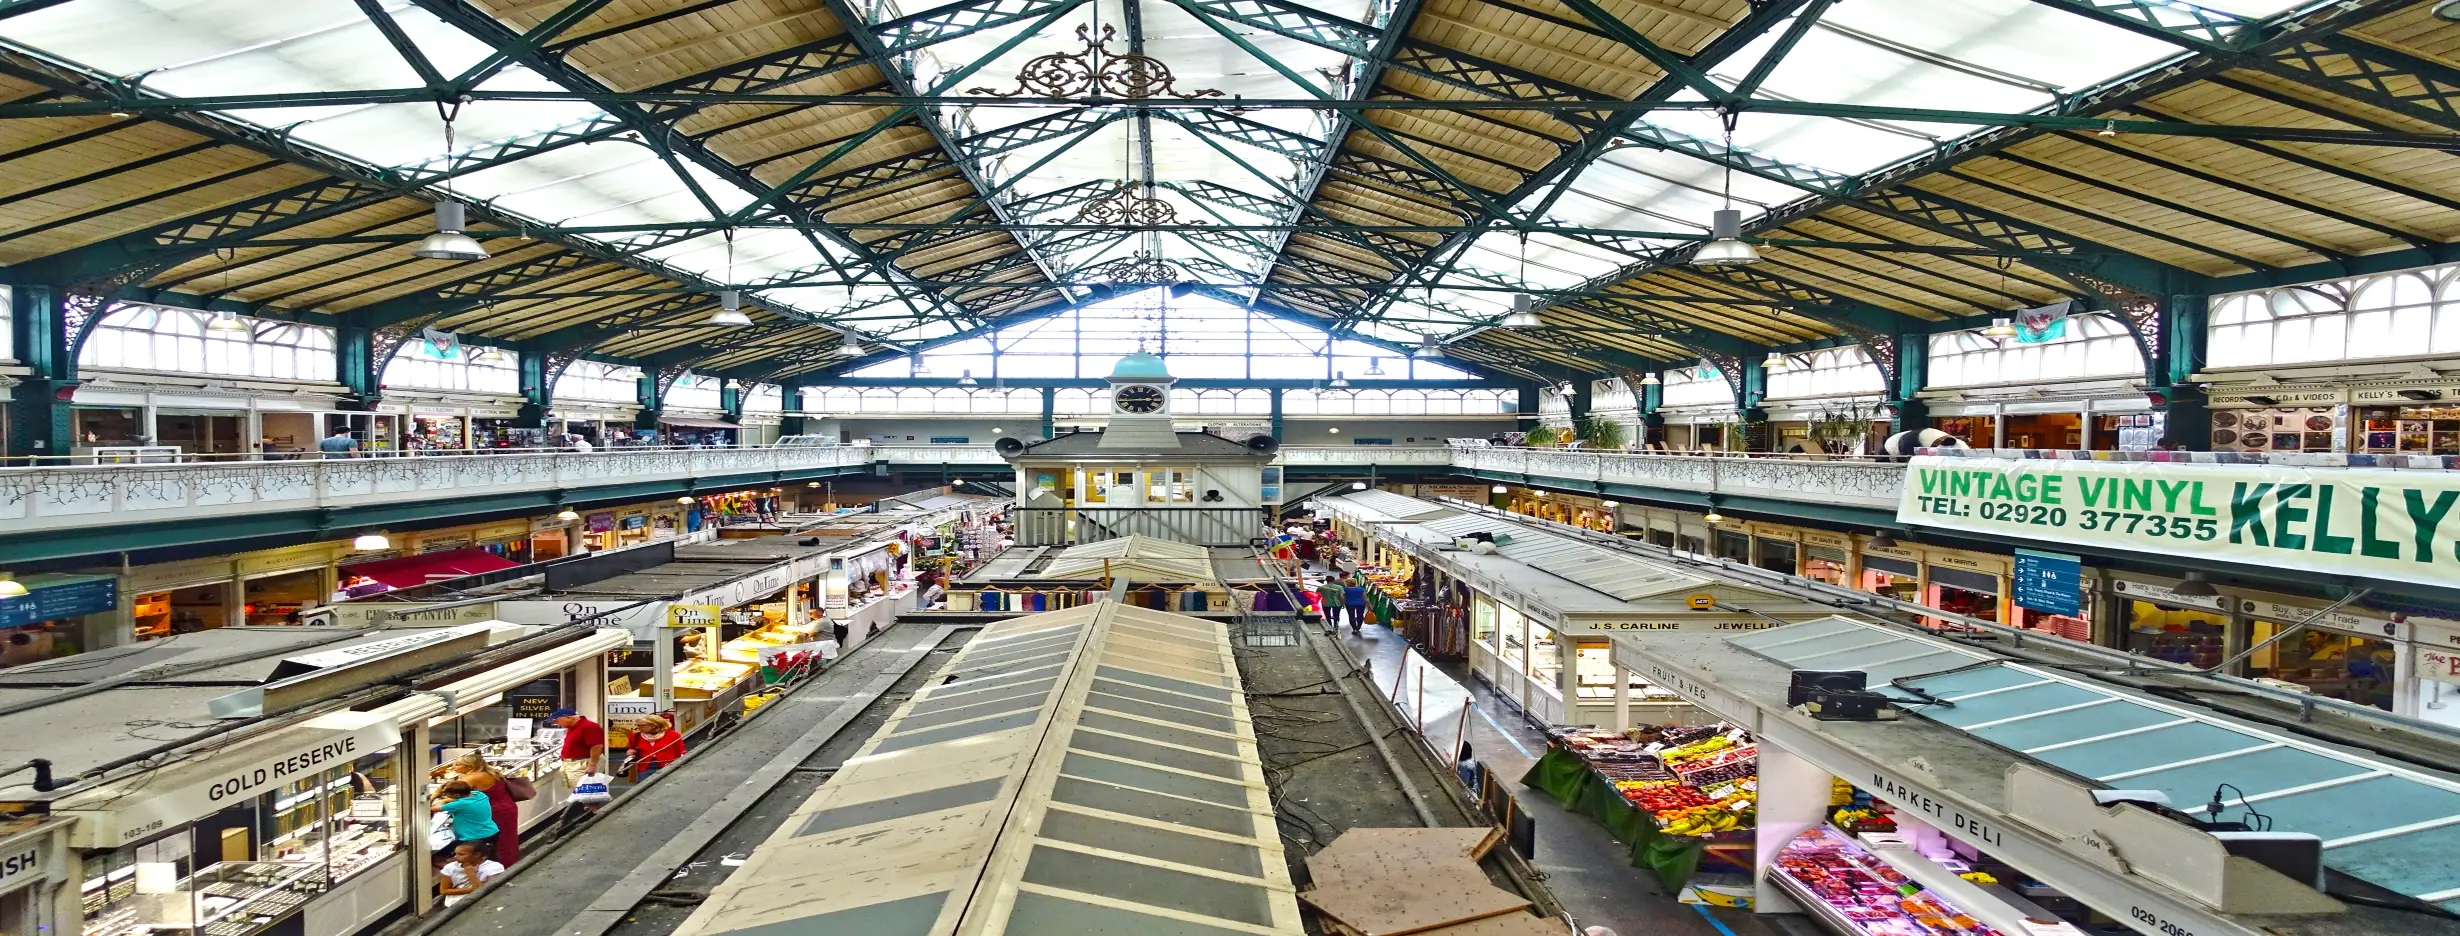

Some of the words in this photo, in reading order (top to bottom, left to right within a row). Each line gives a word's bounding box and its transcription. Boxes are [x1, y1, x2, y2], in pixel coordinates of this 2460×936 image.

[2303, 393, 2335, 401] VIDEOS
[2358, 390, 2393, 399] KELLY'S
[1919, 468, 2063, 504] VINTAGE
[2078, 476, 2217, 516] VINYL
[1918, 495, 1970, 517] TEL:
[1979, 501, 2067, 527] 02920
[2079, 510, 2218, 541] 377355
[2229, 481, 2460, 563] KELLY
[753, 579, 763, 595] On
[763, 575, 780, 589] Time
[414, 608, 459, 621] PANTRY
[562, 602, 598, 616] On
[673, 607, 698, 616] On
[2296, 609, 2315, 617] Sell
[2332, 613, 2360, 626] Trade
[674, 615, 716, 625] Time
[2423, 652, 2446, 664] The
[1652, 666, 1675, 685] FRUIT
[1689, 684, 1707, 699] VEG
[209, 768, 267, 801] GOLD
[273, 736, 356, 779] RESERVE
[1873, 773, 1944, 818] MARKET
[1955, 812, 2001, 847] DELI
[123, 819, 164, 840] 103-109
[2131, 905, 2156, 927] 029
